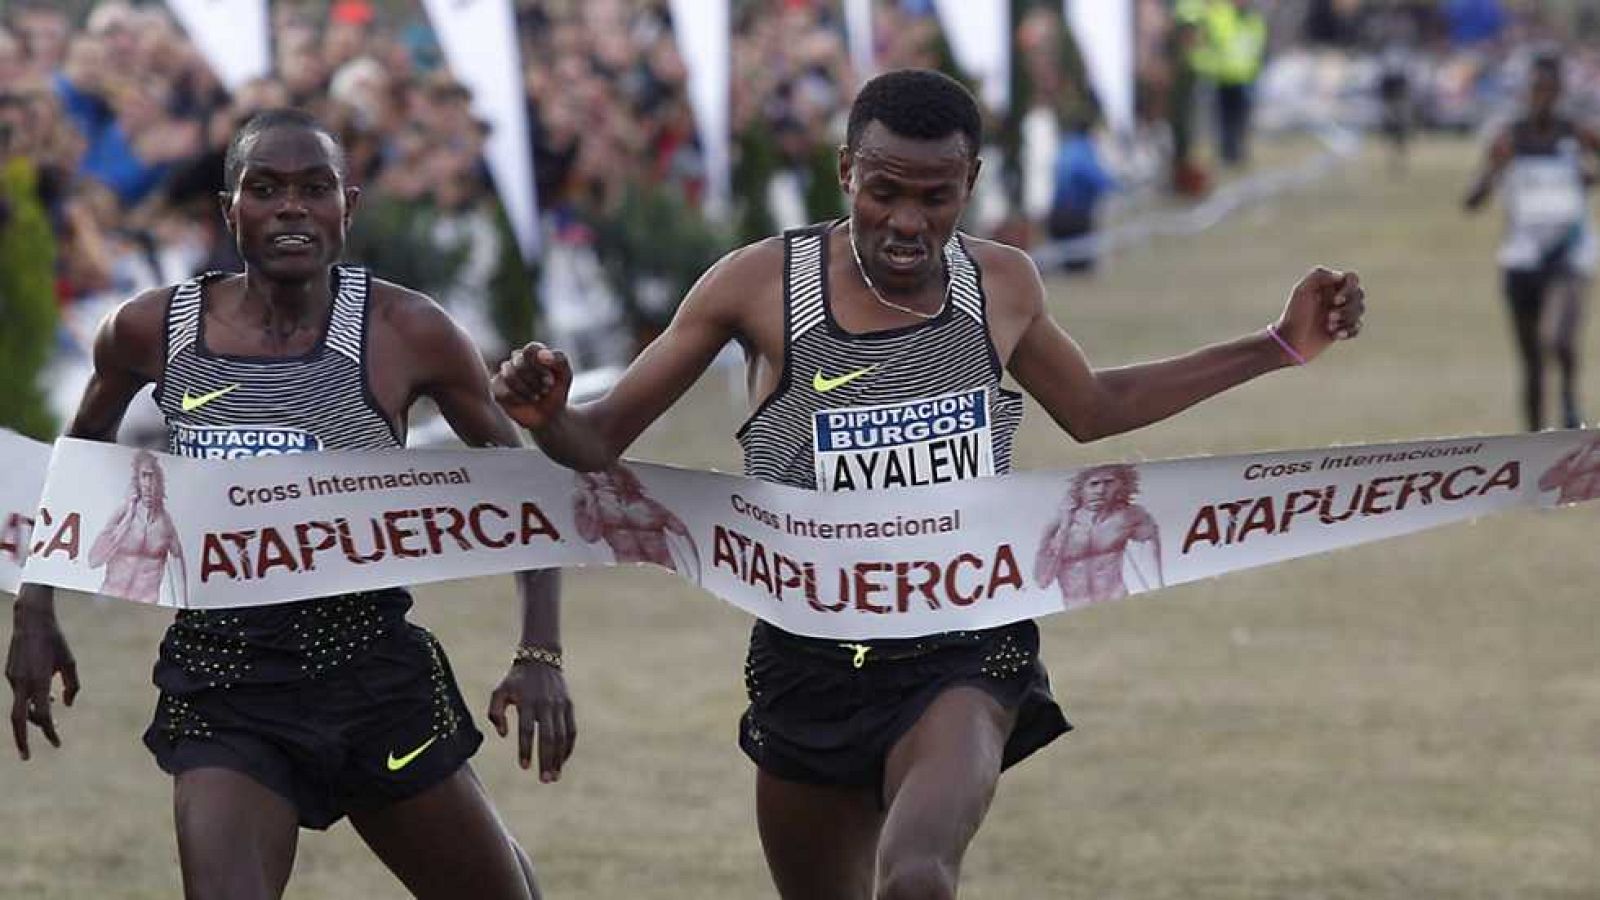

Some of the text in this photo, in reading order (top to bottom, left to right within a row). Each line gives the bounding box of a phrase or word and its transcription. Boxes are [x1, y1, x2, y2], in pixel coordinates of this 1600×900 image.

[829, 393, 975, 430] DIPUTACION
[830, 411, 977, 449] BURGOS
[832, 432, 980, 492] AYALEW
[1243, 442, 1483, 481] Cross Internacional
[228, 467, 471, 507] Cross Internacional
[1181, 460, 1521, 554] ATAPUERCA
[730, 494, 961, 539] Cross Internacional
[201, 501, 561, 583] ATAPUERCA
[713, 525, 1023, 615] ATAPUERCA
